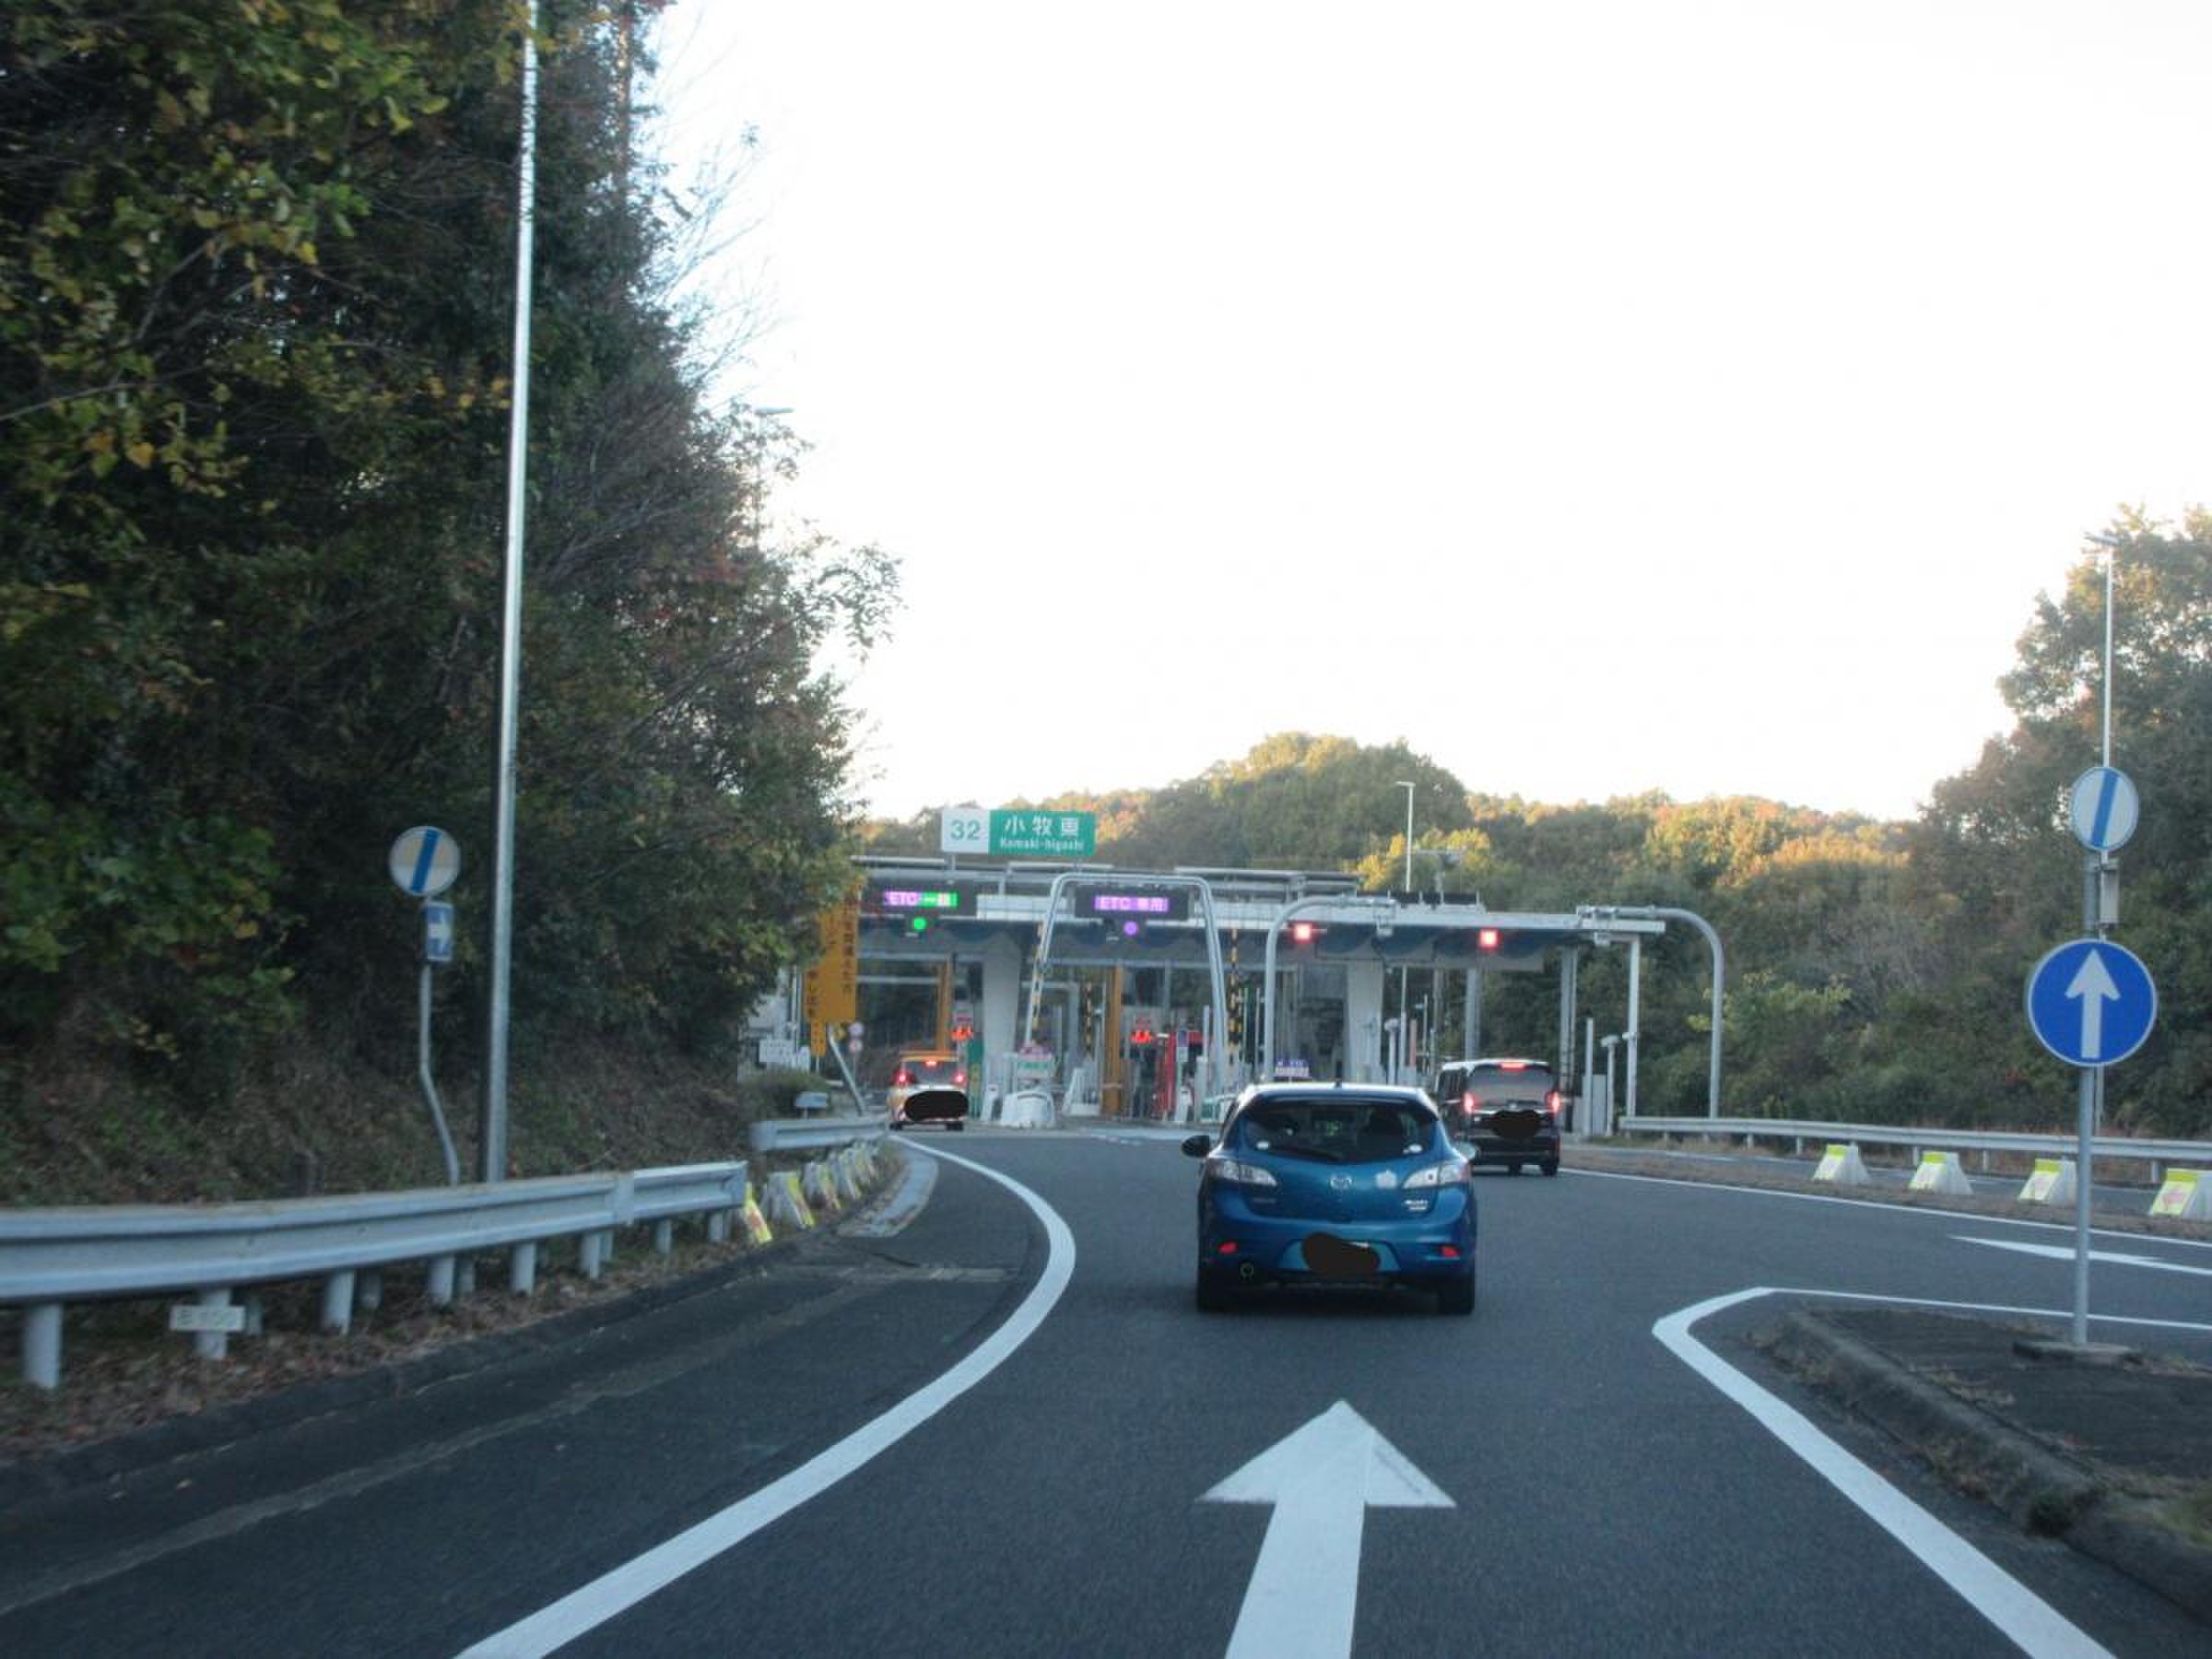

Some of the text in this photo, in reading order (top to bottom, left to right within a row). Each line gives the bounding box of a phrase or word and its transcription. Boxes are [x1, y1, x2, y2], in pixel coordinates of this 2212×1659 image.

[950, 819, 981, 841] 32
[1004, 815, 1080, 837] 小牧東
